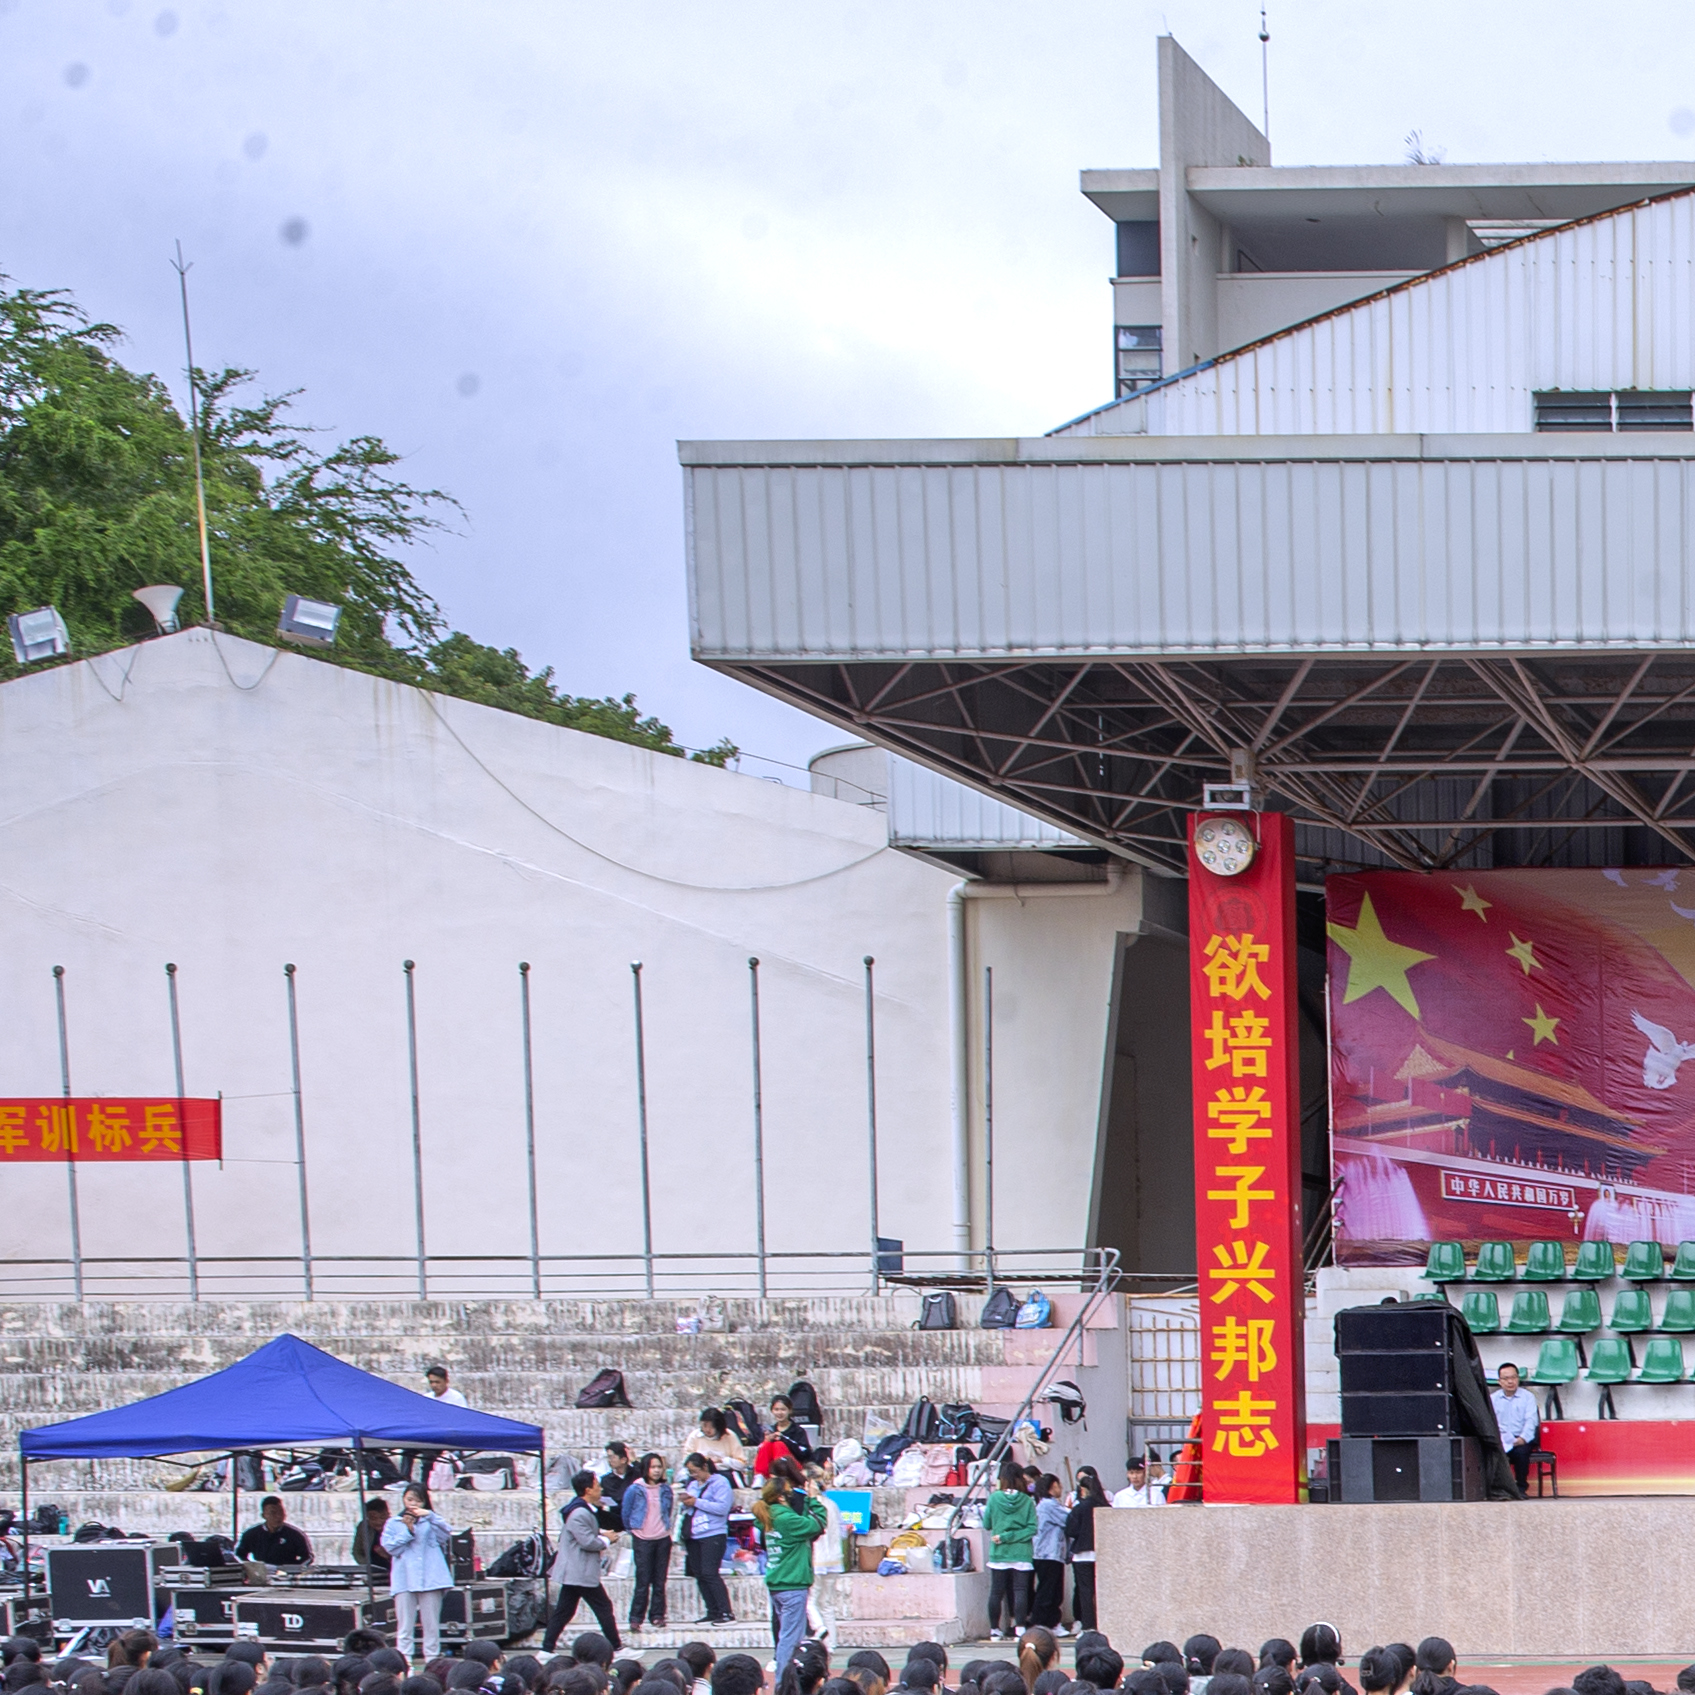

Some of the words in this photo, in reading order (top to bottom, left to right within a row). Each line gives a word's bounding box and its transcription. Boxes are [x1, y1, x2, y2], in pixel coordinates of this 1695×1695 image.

[1203, 933, 1279, 1457] 欲培学子兴邦志
[1451, 1176, 1570, 1206] 中华人民共和国万岁
